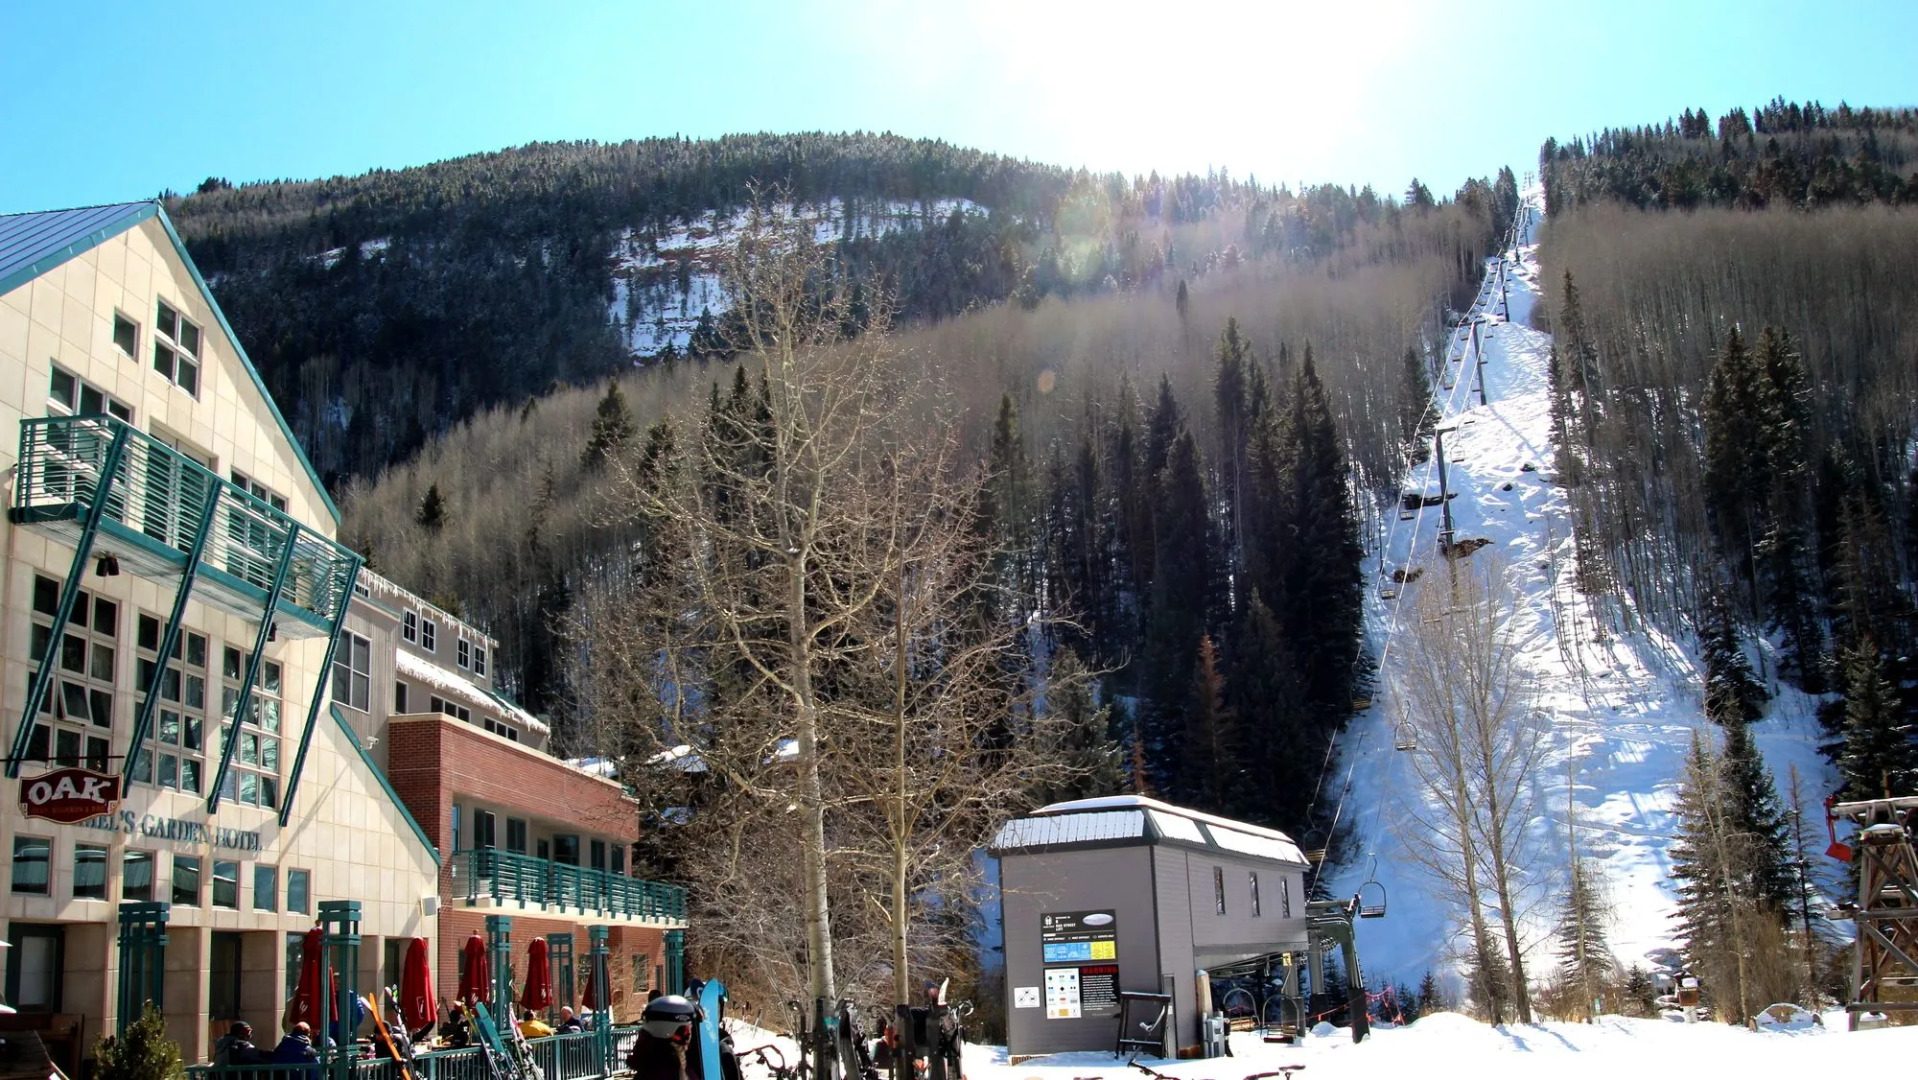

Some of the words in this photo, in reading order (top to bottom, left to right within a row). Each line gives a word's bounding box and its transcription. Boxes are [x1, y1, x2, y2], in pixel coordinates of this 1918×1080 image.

[28, 776, 111, 805] OAK
[141, 813, 212, 844] GARDEN
[215, 826, 262, 852] HOTEL
